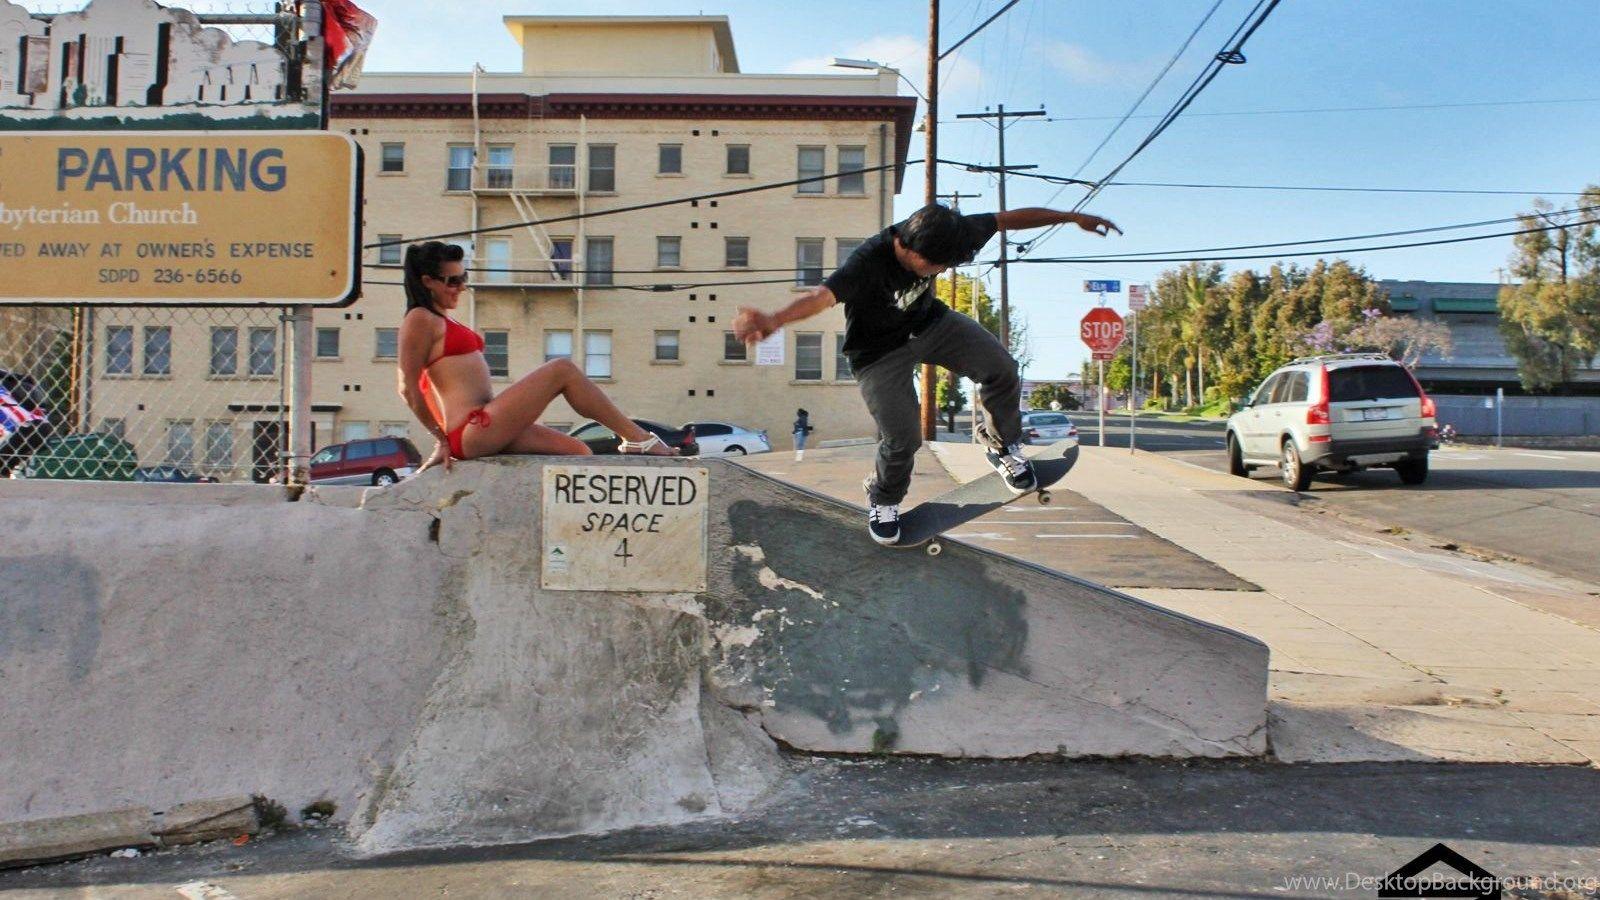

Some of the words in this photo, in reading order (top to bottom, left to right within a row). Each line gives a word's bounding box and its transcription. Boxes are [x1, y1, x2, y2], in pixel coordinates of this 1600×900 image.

[56, 147, 288, 192] PARKING
[107, 202, 198, 225] Church
[0, 242, 25, 258] ED
[37, 242, 90, 258] AWAY
[100, 242, 122, 258] AT
[137, 239, 215, 258] OWNER'S
[230, 242, 314, 258] EXPENSE
[98, 268, 140, 284] SDPD
[153, 268, 243, 284] 236-6566
[1082, 321, 1122, 339] STOP
[554, 473, 698, 506] RESERVED
[581, 512, 664, 533] SPACE
[614, 537, 634, 567] 4
